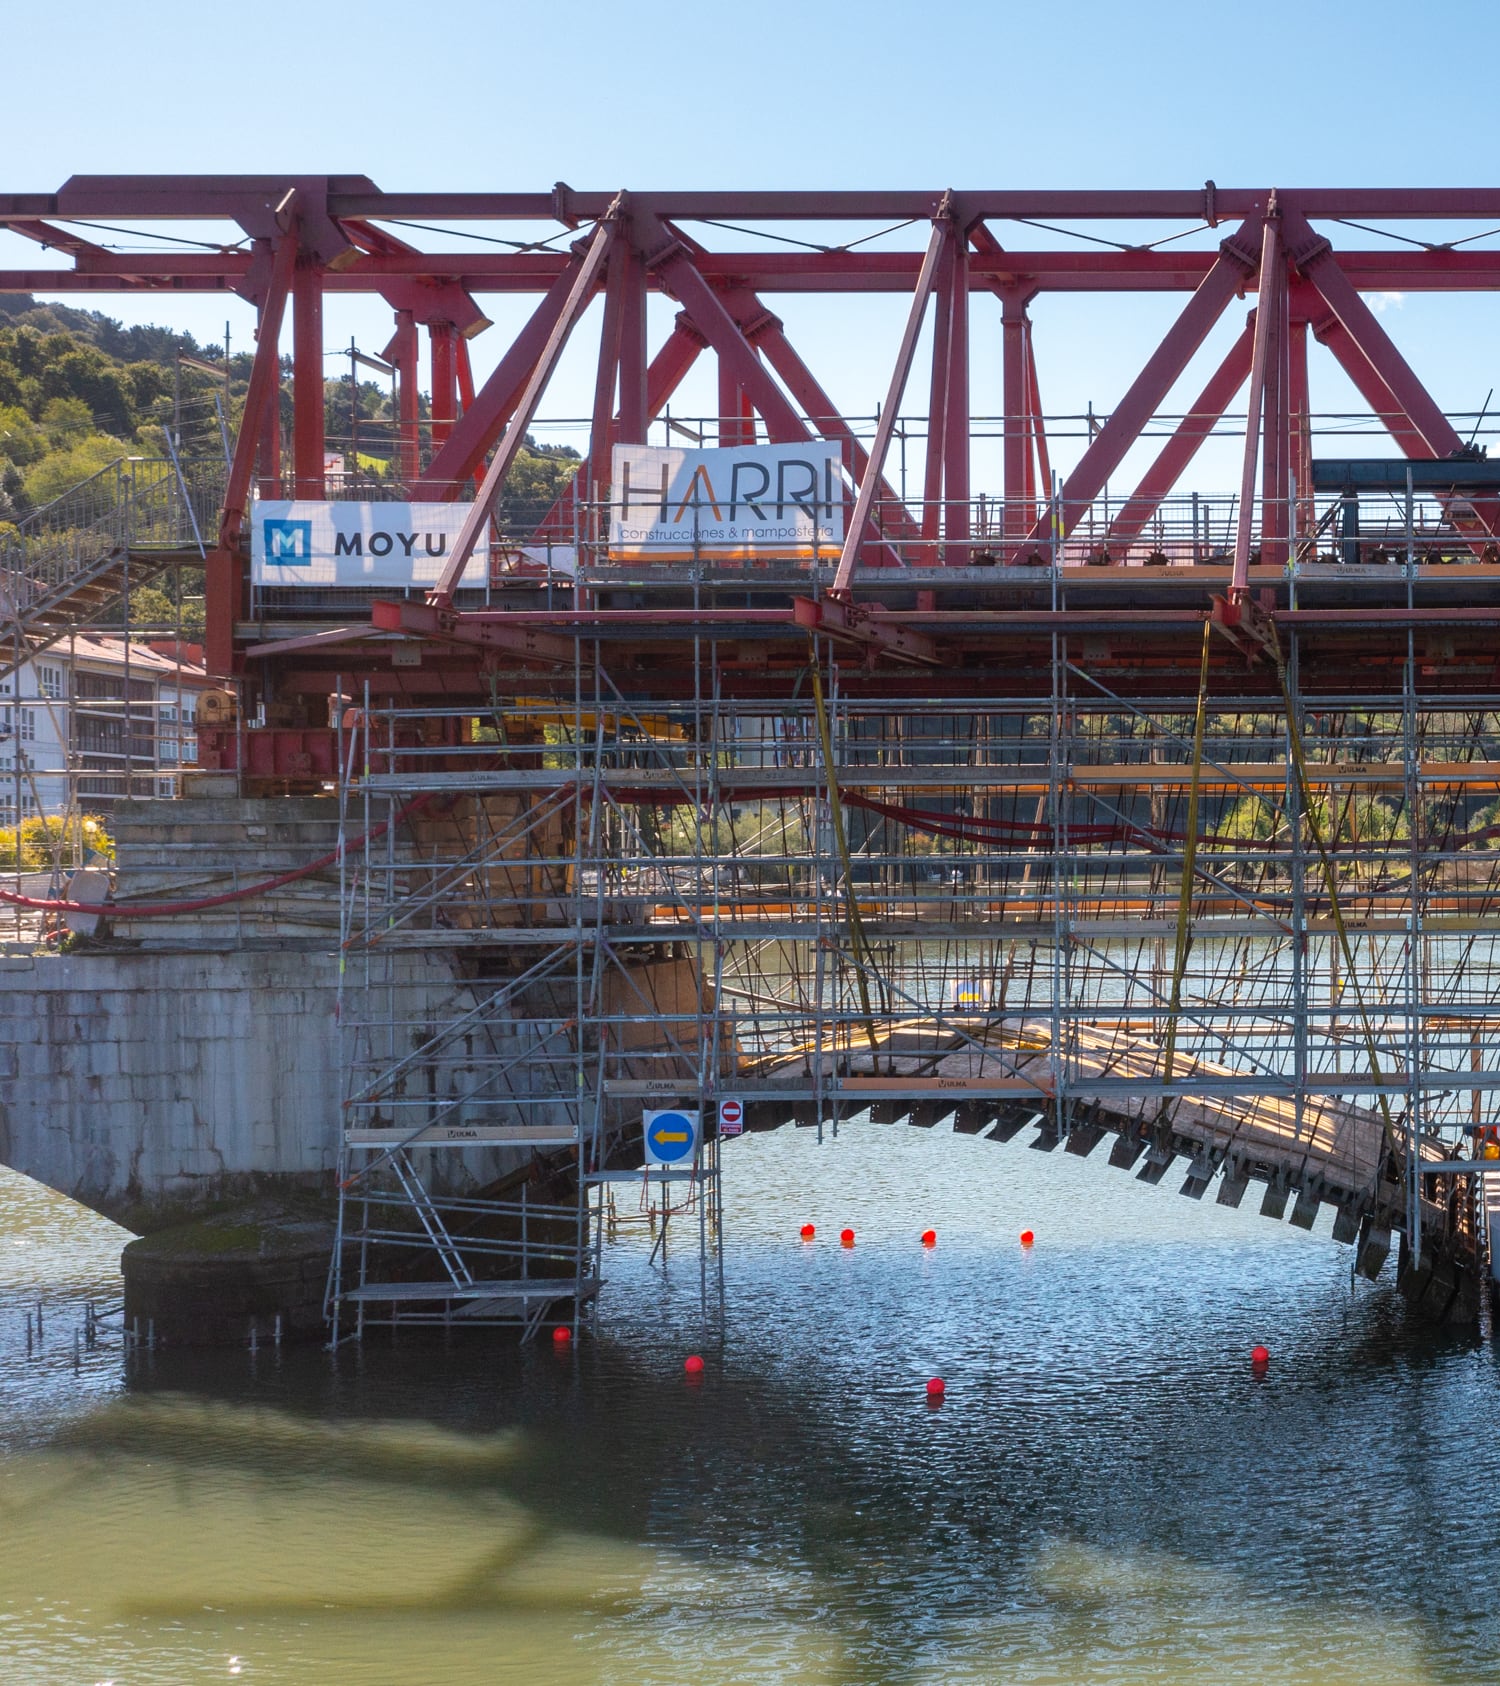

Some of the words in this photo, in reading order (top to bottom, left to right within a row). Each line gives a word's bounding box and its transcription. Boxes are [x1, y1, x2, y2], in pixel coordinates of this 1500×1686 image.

[621, 458, 832, 523] HARRI
[334, 531, 474, 557] MOYU
[620, 526, 724, 540] construcciones
[729, 527, 738, 538] &
